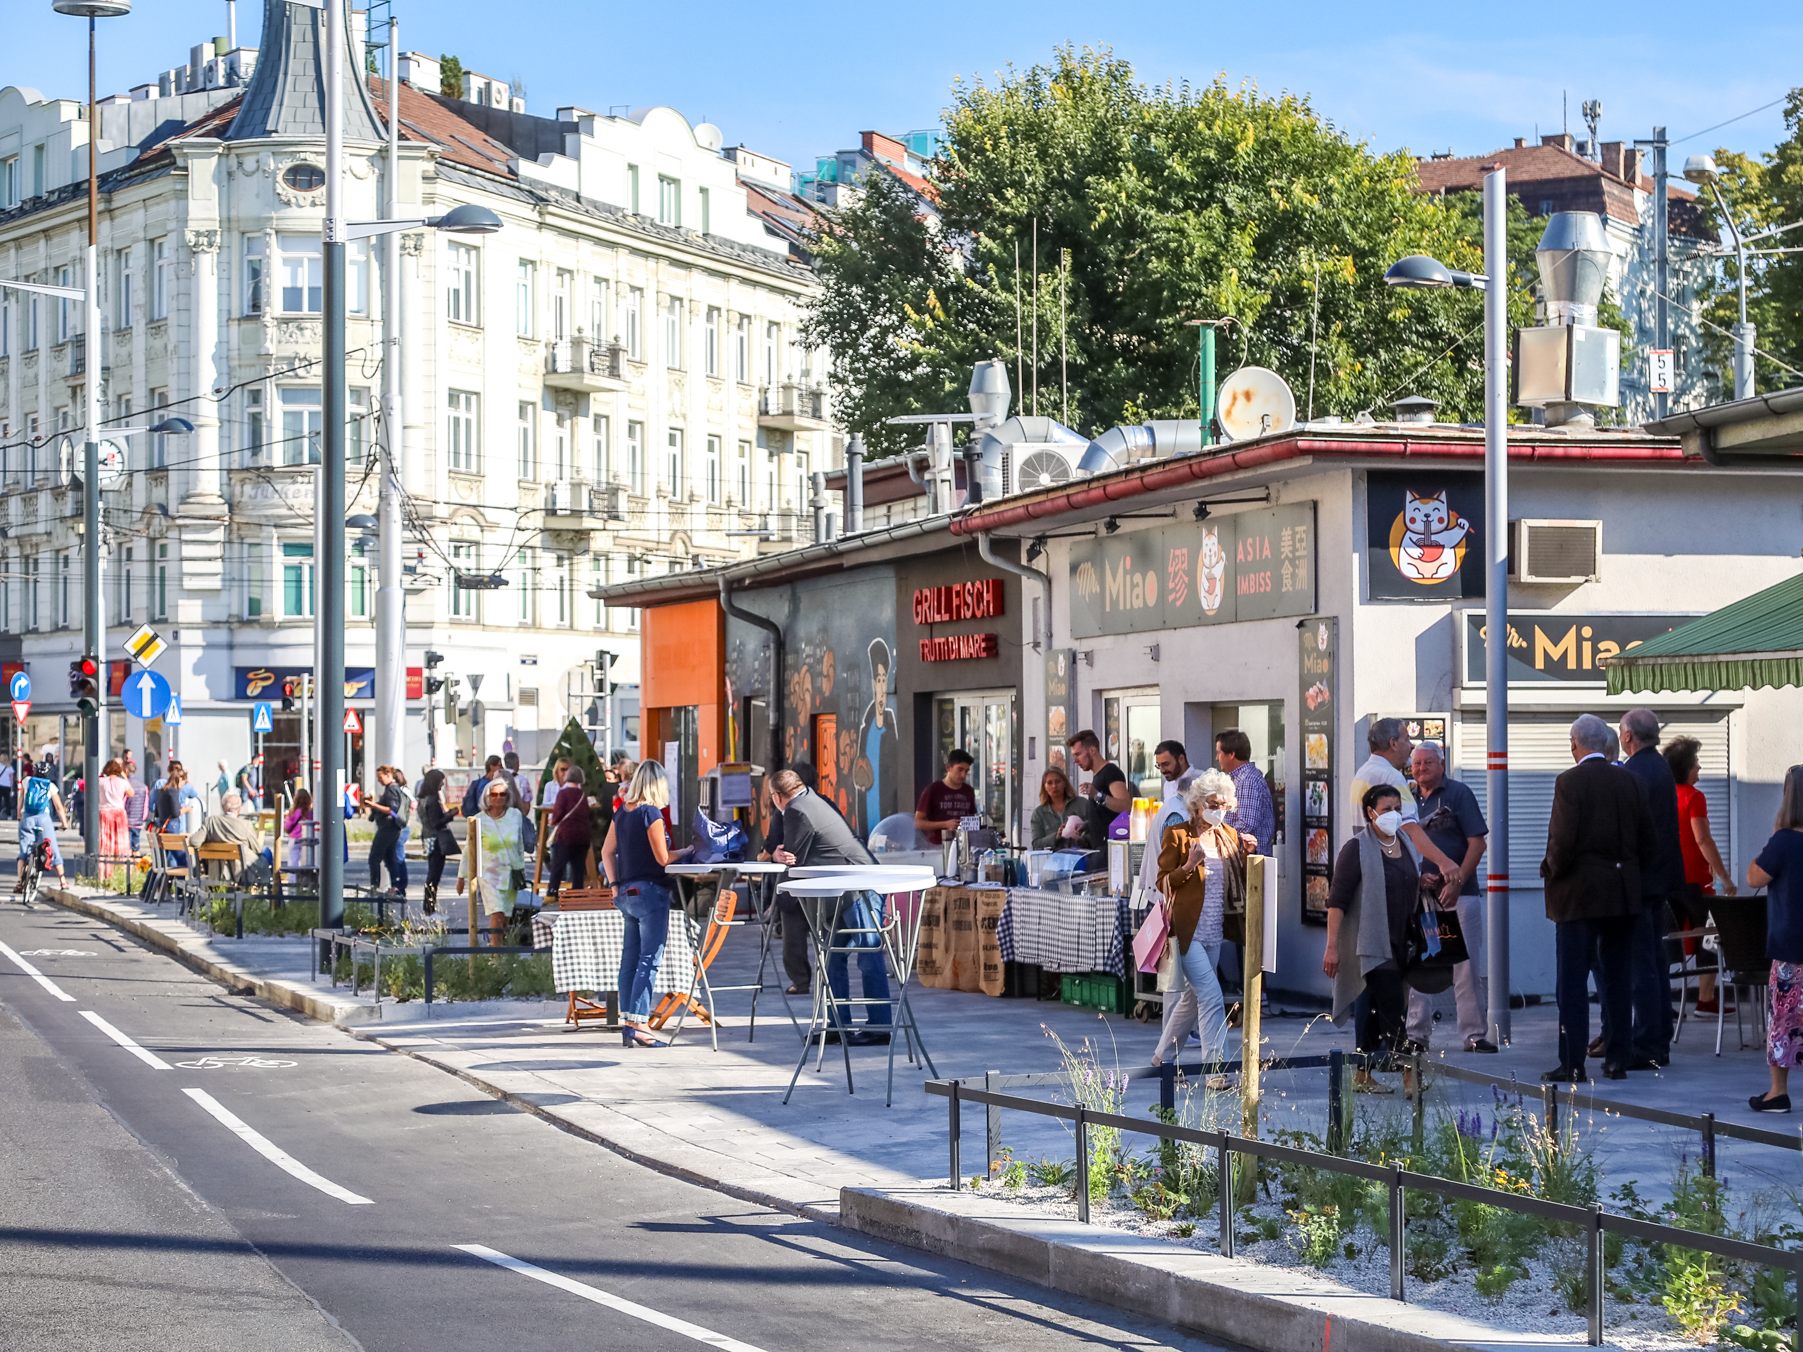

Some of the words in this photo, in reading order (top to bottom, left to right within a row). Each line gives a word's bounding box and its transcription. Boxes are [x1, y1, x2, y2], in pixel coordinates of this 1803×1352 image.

[1237, 535, 1271, 561] ASIA
[1105, 555, 1158, 612] Miao
[1237, 570, 1272, 596] IMBISS
[913, 586, 950, 625] GRILL
[952, 579, 993, 620] FISCH
[919, 638, 948, 661] FRUTTI
[948, 634, 959, 660] DI
[960, 632, 987, 658] MARE
[1304, 653, 1329, 674] Miao
[1048, 679, 1066, 696] Miao
